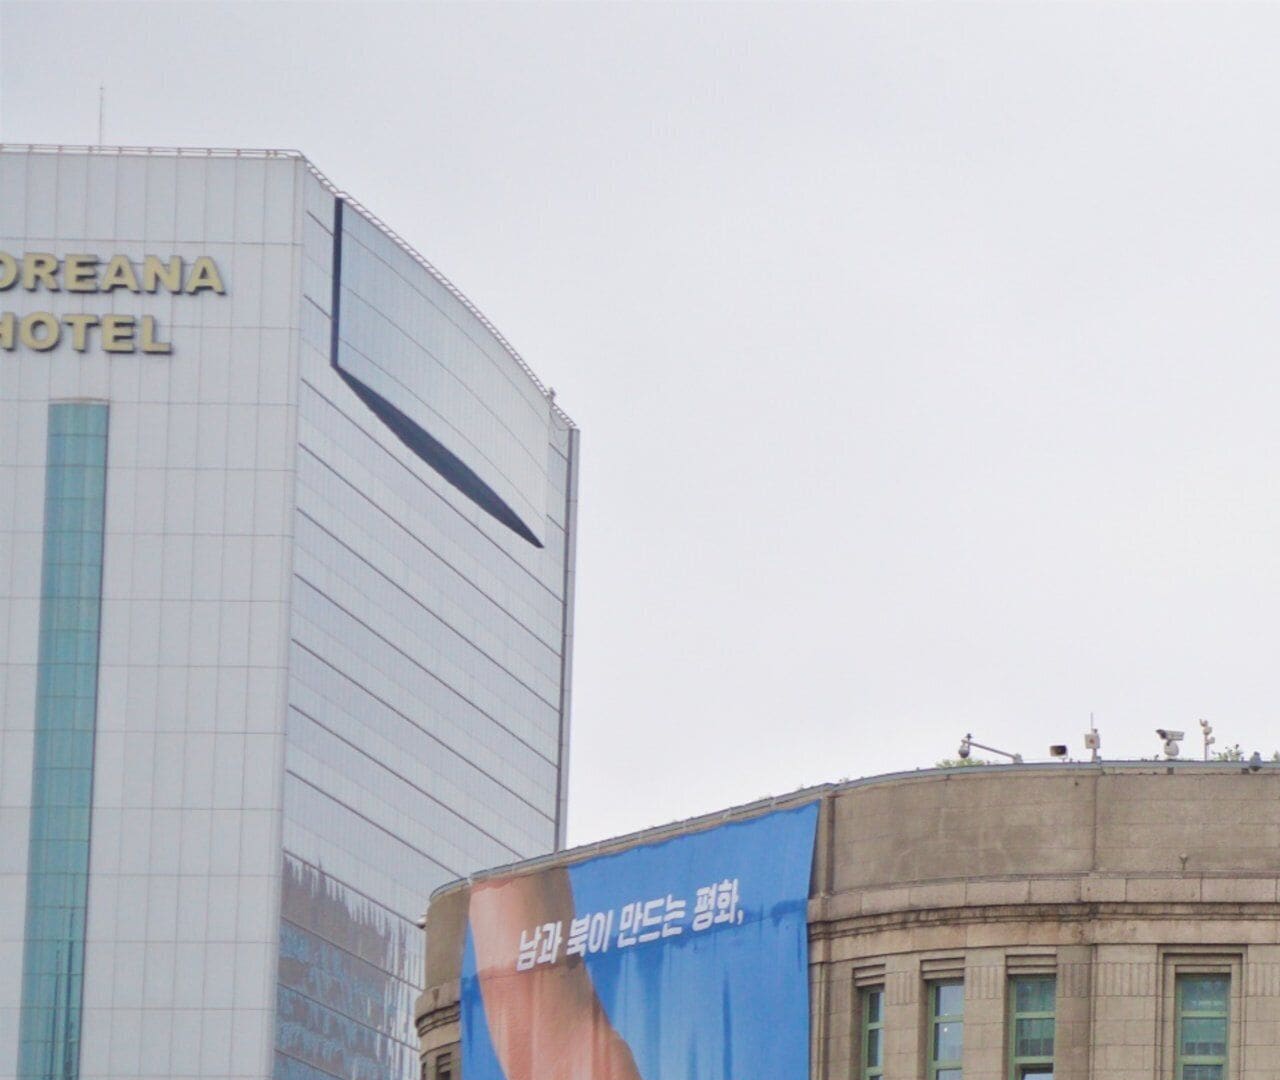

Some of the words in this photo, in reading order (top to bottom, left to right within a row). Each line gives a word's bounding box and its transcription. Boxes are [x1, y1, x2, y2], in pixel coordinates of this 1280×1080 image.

[516, 921, 562, 971] 남과
[567, 909, 613, 957] 북이
[617, 894, 686, 948] 만드는
[692, 878, 744, 932] 평화,
